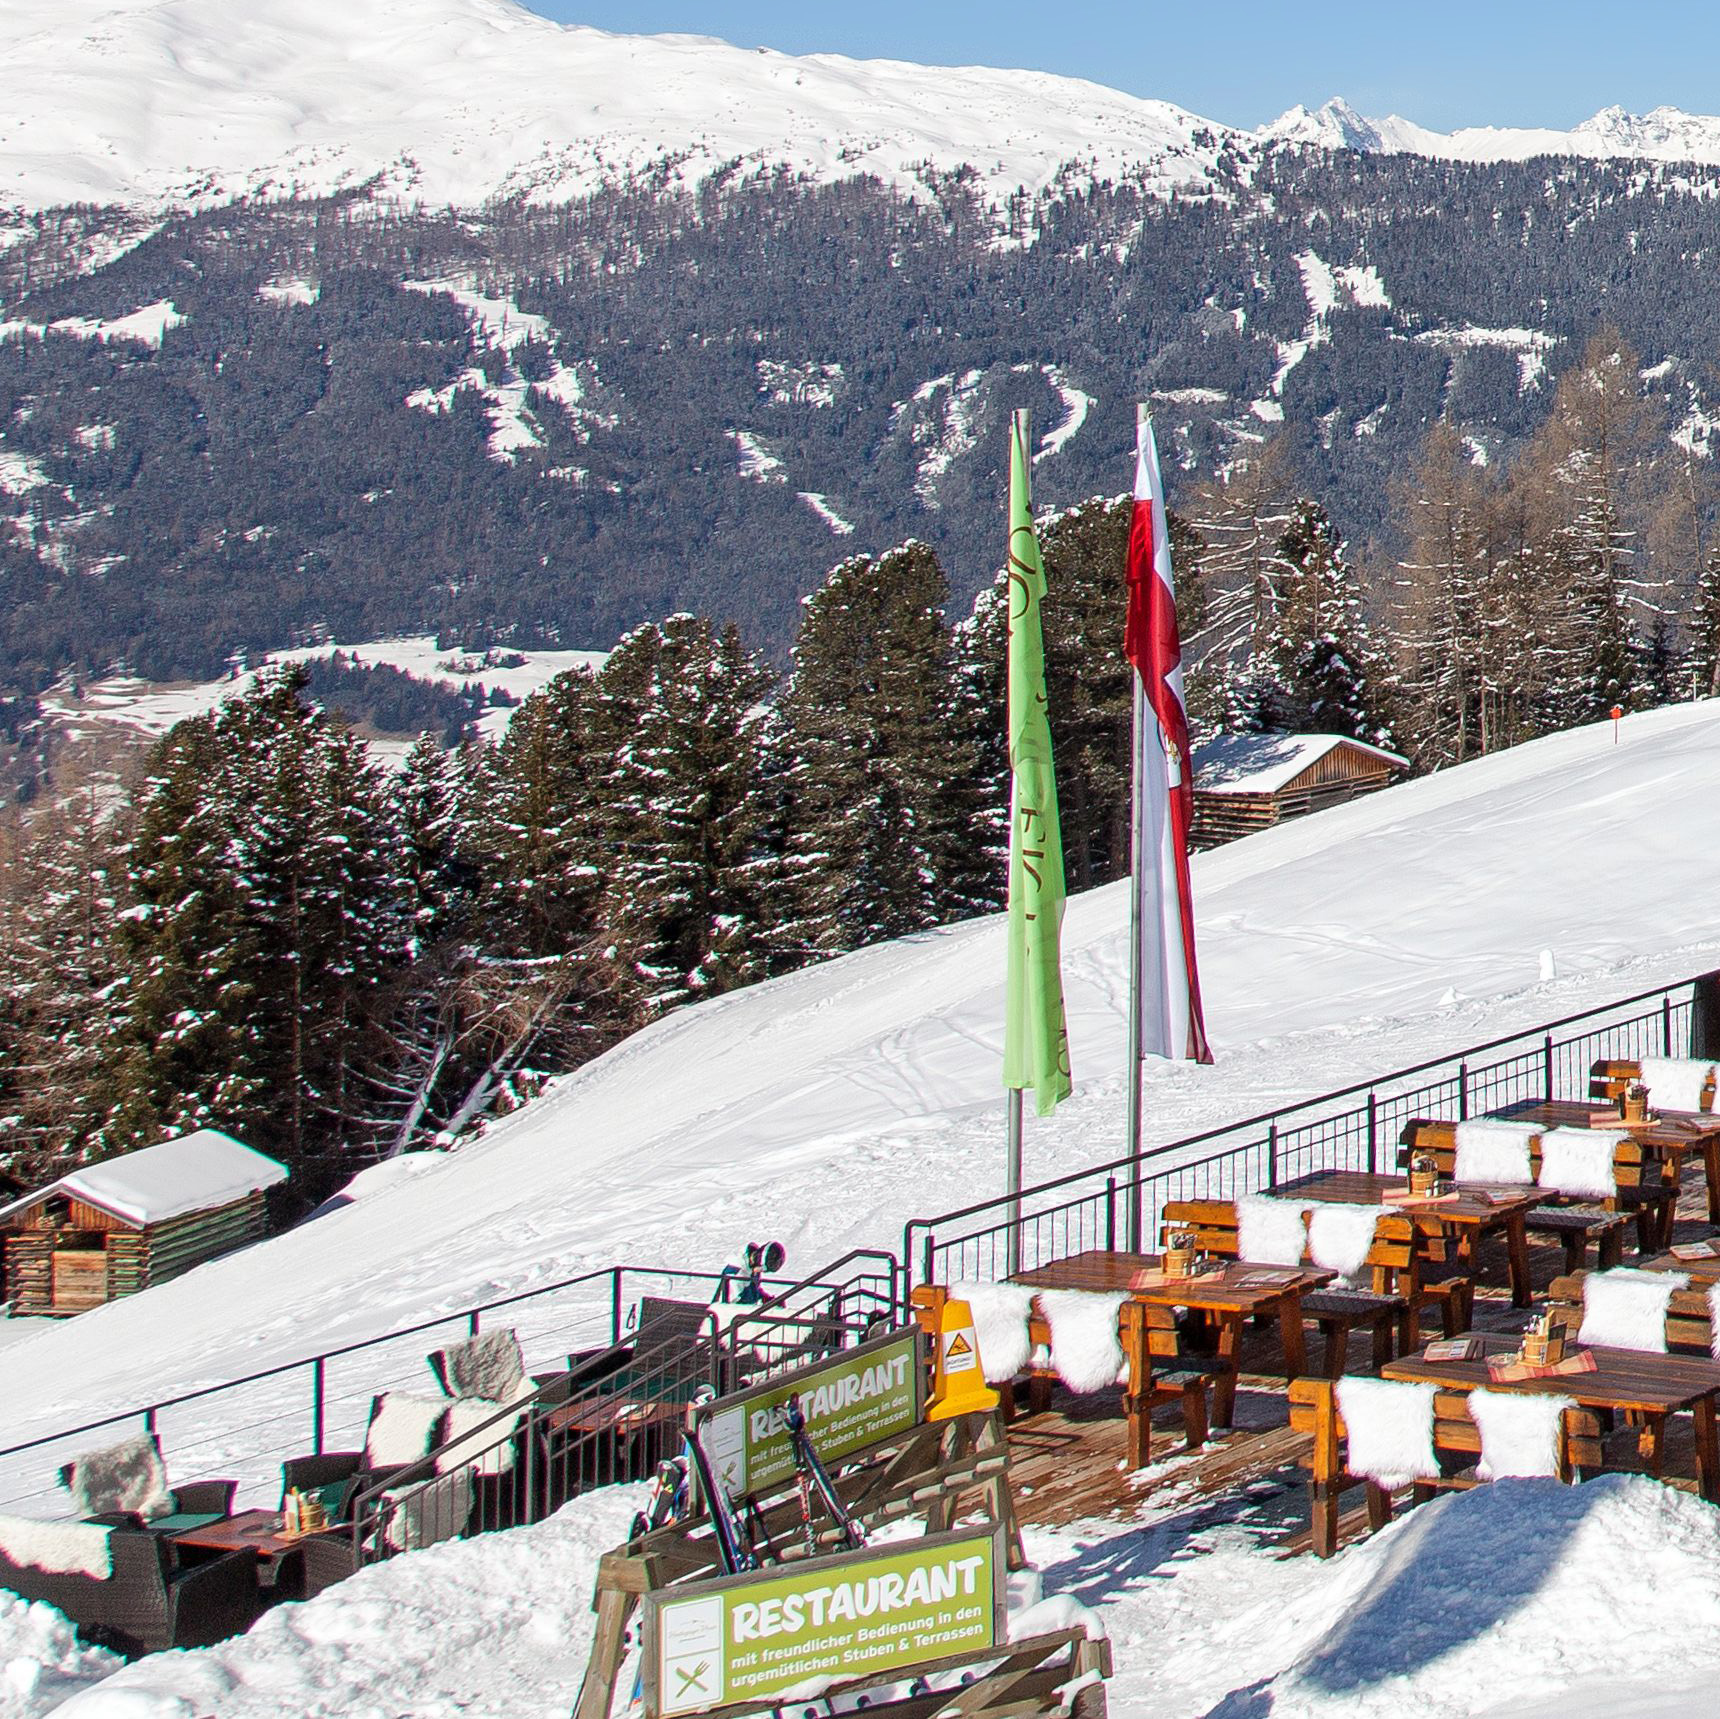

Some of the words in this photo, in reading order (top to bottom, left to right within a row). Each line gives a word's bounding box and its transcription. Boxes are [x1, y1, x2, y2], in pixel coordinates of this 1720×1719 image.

[751, 1354, 910, 1443] RETAURANT
[821, 1430, 855, 1451] Stuben
[856, 1425, 864, 1438] &
[866, 1408, 910, 1433] Terrassen
[830, 1406, 879, 1432] Bedienung
[880, 1401, 892, 1414] in
[892, 1394, 909, 1408] den
[731, 1555, 985, 1644] RESTAURANT
[731, 1650, 758, 1669] mit
[762, 1633, 853, 1662] freundlicher
[857, 1614, 934, 1643] Bedienung
[938, 1610, 952, 1625] in
[955, 1604, 983, 1622] den
[731, 1655, 839, 1688] urgemütlichen
[843, 1641, 894, 1664] Stuben
[898, 1637, 910, 1651] &
[913, 1622, 984, 1649] Terrassen
